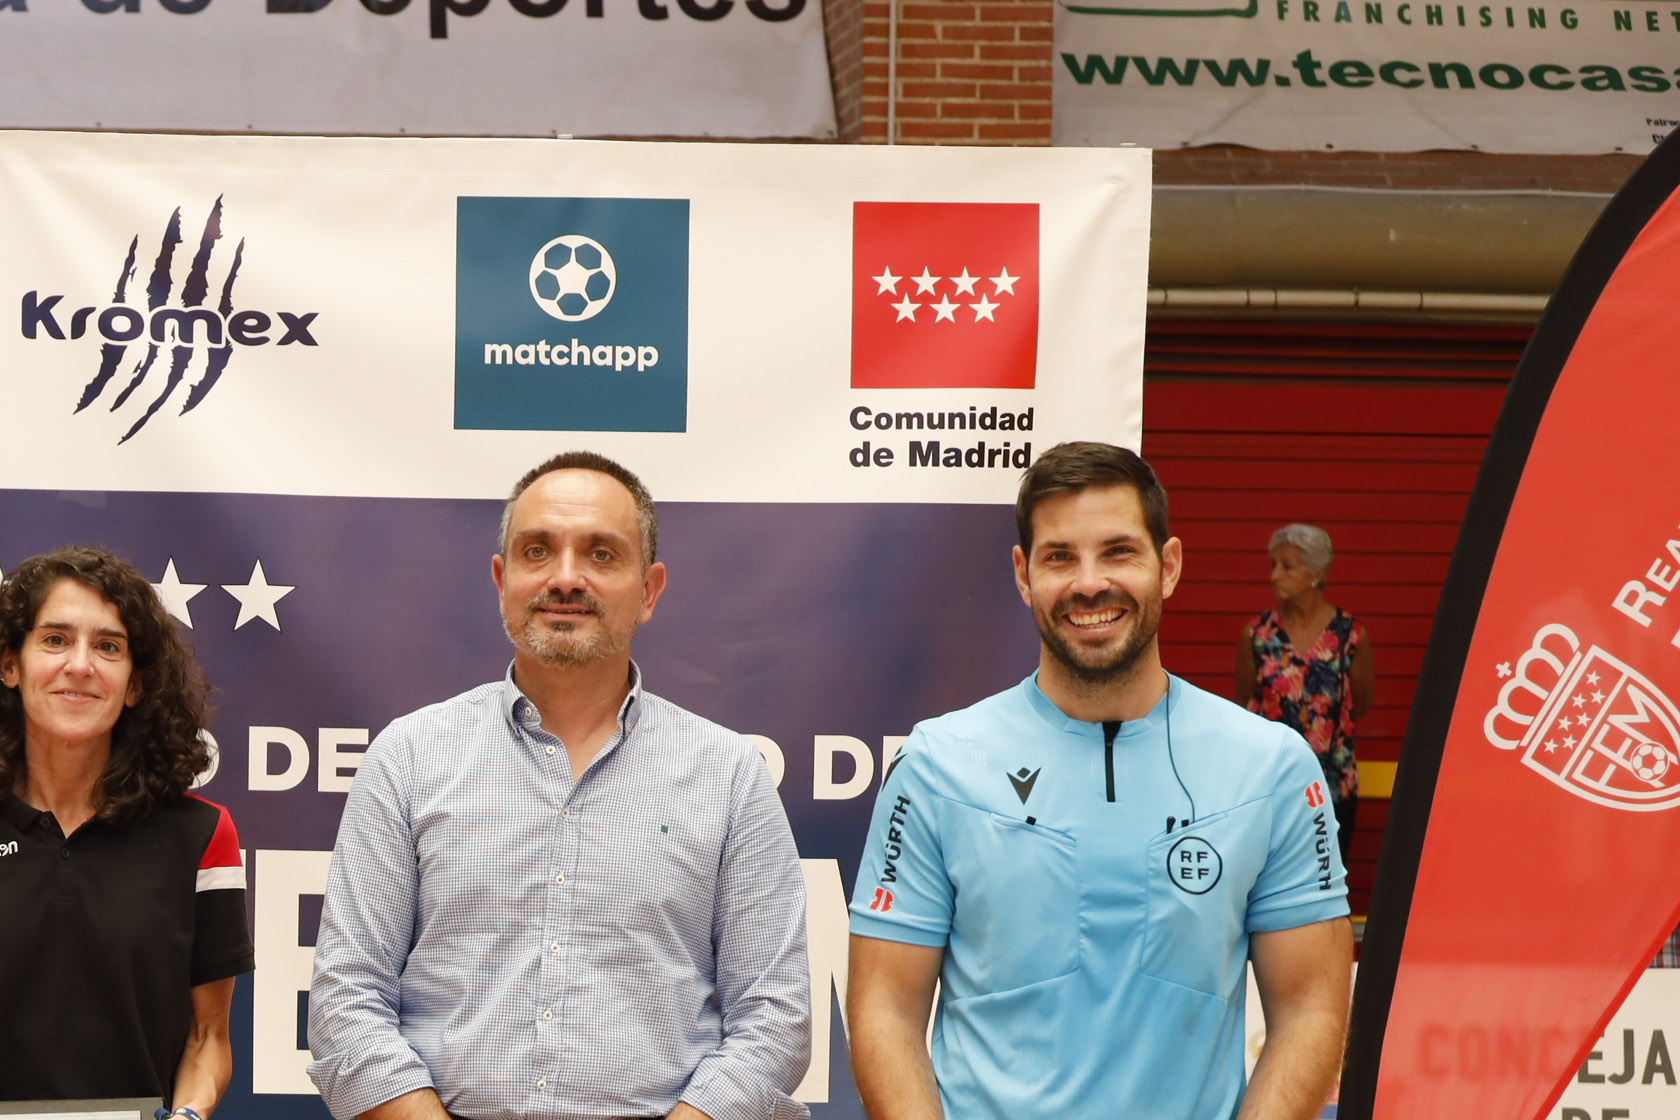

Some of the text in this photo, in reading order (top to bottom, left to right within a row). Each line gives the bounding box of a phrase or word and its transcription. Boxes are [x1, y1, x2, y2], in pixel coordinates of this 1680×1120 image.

[1277, 0, 1579, 30] FRANCHISING
[1061, 49, 1680, 93] www.tecnocas
[21, 290, 319, 347] Kromex
[484, 338, 659, 372] matchapp
[849, 405, 1035, 432] Comunidad
[848, 440, 1032, 470] de Madrid
[881, 796, 910, 885] WÜRTH
